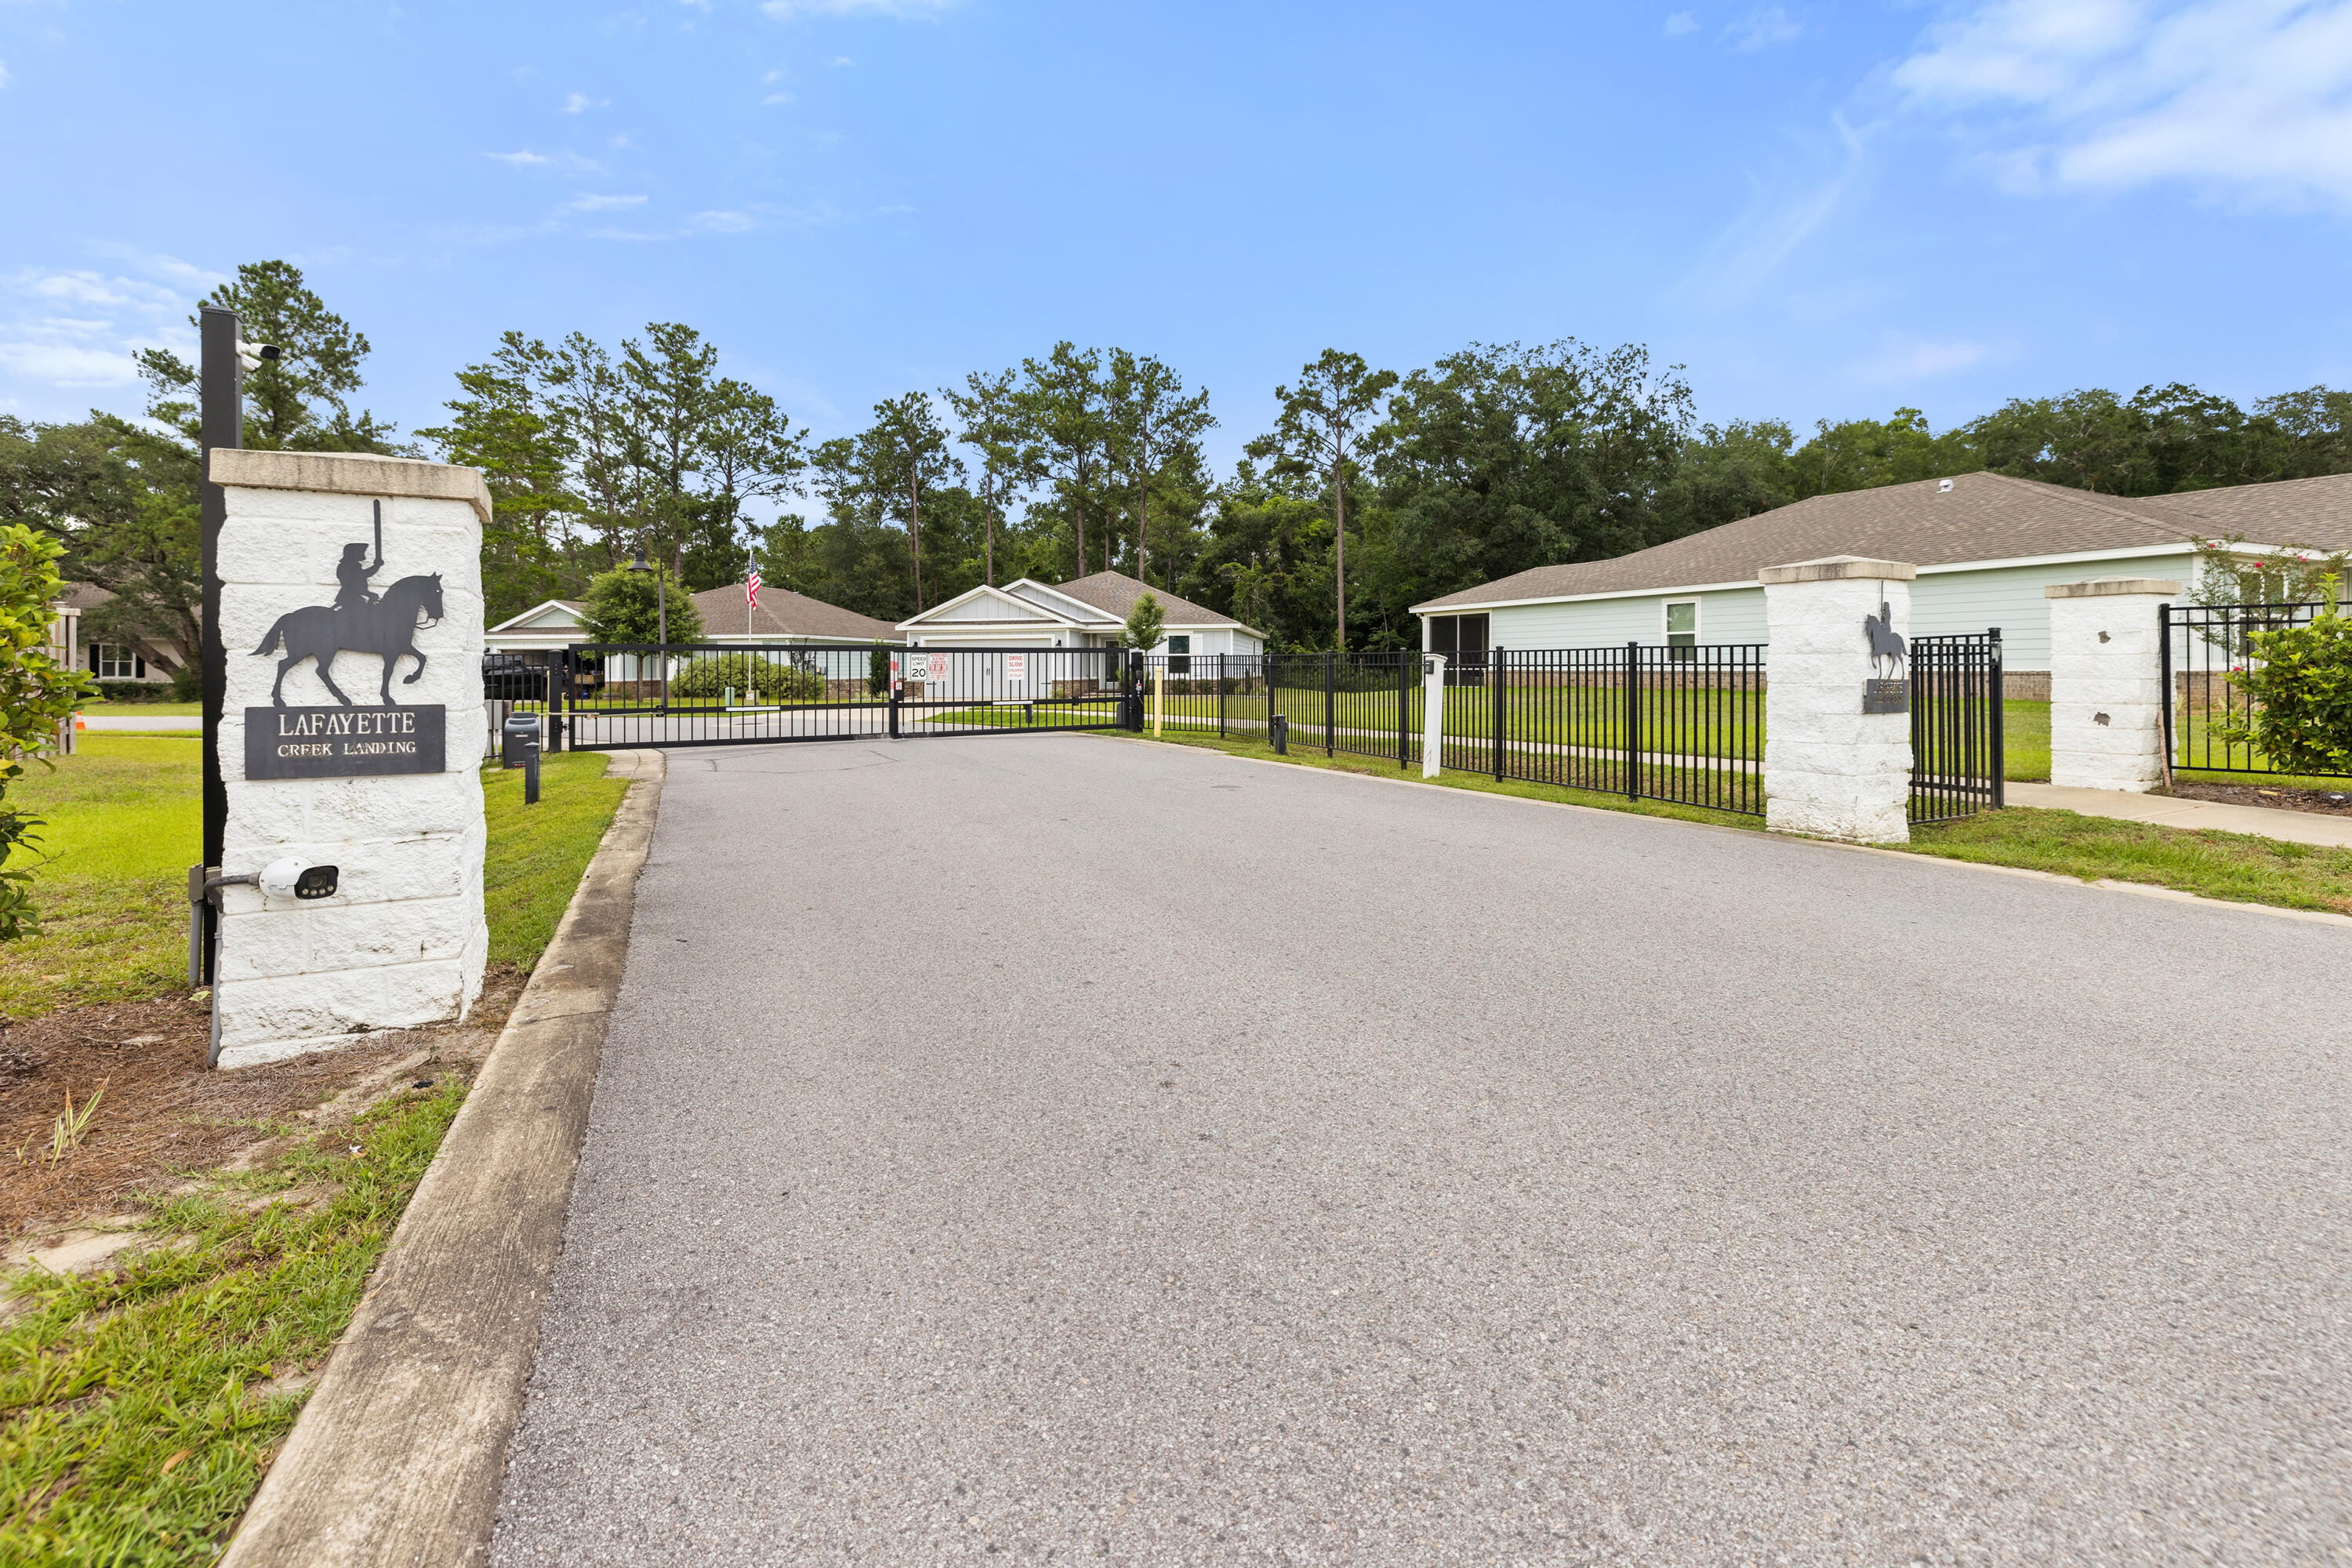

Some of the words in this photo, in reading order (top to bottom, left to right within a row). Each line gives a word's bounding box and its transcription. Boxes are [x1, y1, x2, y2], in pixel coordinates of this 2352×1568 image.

[912, 669, 926, 677] 20
[278, 712, 416, 736] LAFAYETTE
[277, 743, 333, 757] CREEK
[343, 741, 417, 755] LANDING
